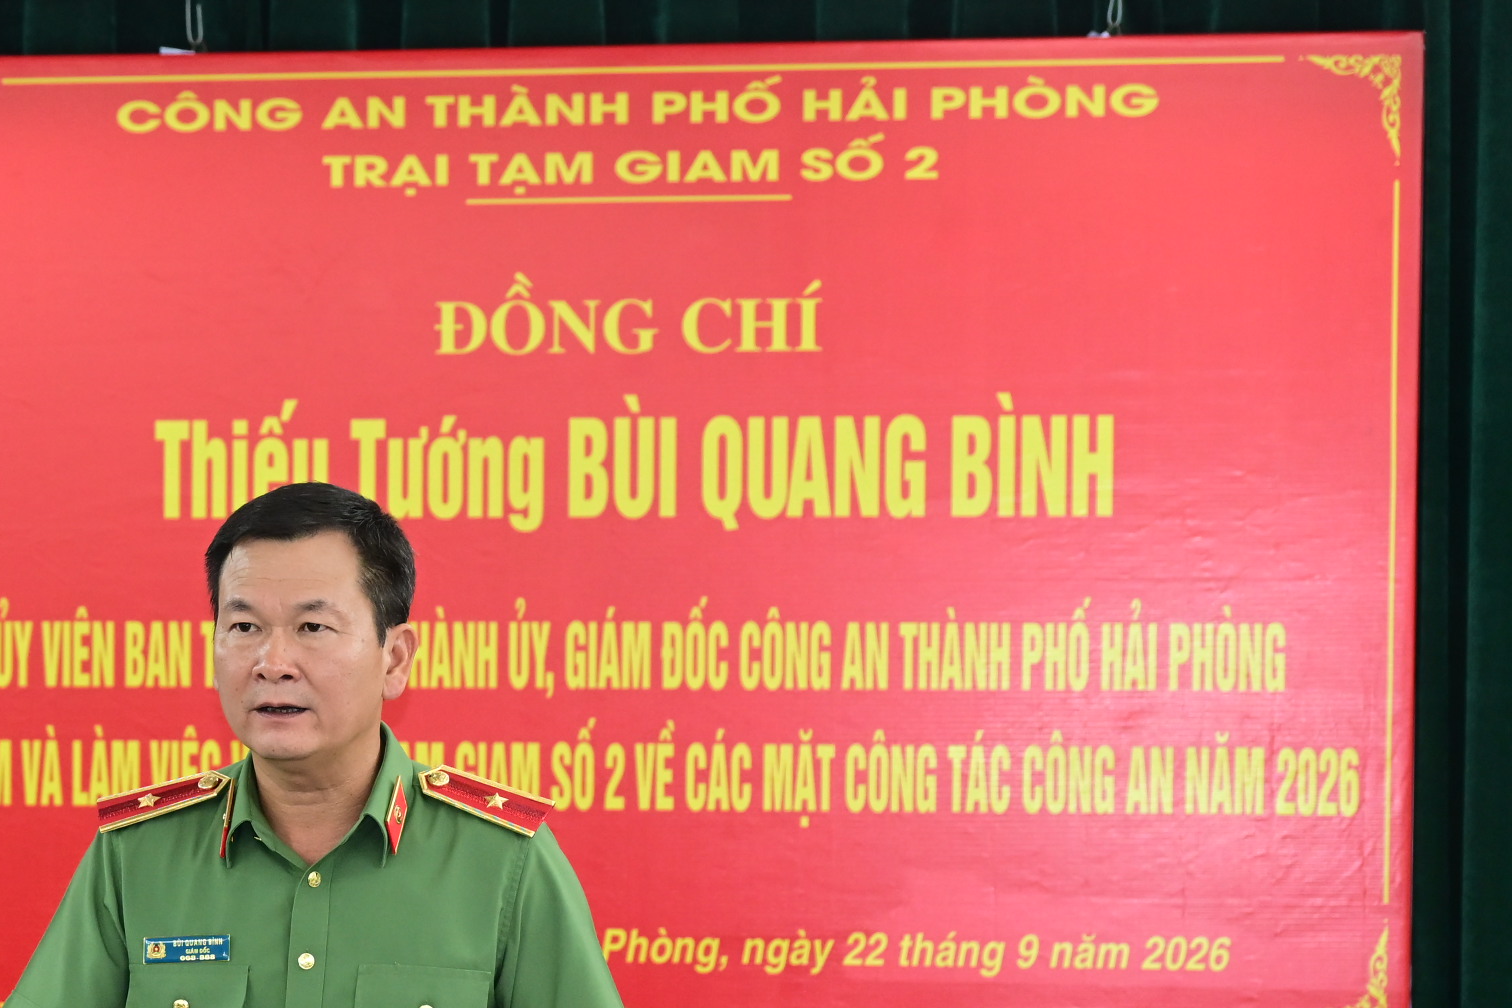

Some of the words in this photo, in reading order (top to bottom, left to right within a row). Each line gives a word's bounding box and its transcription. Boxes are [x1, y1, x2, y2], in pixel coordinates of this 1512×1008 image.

[117, 91, 303, 133] CÔNG
[323, 96, 406, 129] AN
[426, 85, 629, 128] THÀNH
[653, 75, 782, 124] PHỐ
[803, 76, 907, 121] HẢI
[931, 76, 1159, 120] PHÒNG
[323, 154, 449, 196] TRẠI
[469, 152, 594, 195] TẠM
[616, 149, 780, 184] GIAM
[801, 133, 884, 181] SỐ
[906, 146, 939, 180] 2
[436, 272, 657, 355] ĐỒNG
[682, 280, 822, 353] CHÍ
[155, 399, 329, 519] Thiếu
[350, 415, 545, 532] Tướng
[568, 394, 677, 519] BÙI
[702, 414, 927, 530] QUANG
[952, 392, 1114, 517] BÌNH
[42, 606, 116, 688] VIÊN
[125, 621, 192, 688] BAN
[408, 607, 499, 688] HÀNH
[509, 598, 555, 697] ỦY,
[566, 607, 652, 690] GIÁM
[661, 597, 729, 690] ĐỐC
[740, 607, 832, 690] CÔNG
[842, 622, 889, 690] AN
[900, 608, 1011, 690] THÀNH
[1023, 598, 1090, 690] PHỐ
[1102, 600, 1157, 690] HẢI
[1170, 607, 1285, 691] PHÒNG
[21, 725, 82, 806] VÀ
[90, 725, 140, 806] LÀM
[550, 718, 596, 811] SỐ
[605, 743, 626, 810] 2
[635, 720, 675, 811] VỀ
[686, 729, 752, 812] CÁC
[764, 730, 835, 827] MẶT
[846, 730, 937, 813] CÔNG
[949, 731, 1010, 813] TÁC
[1024, 731, 1115, 814] CÔNG
[1127, 747, 1174, 814] AN
[1186, 731, 1265, 814] NĂM
[1277, 748, 1359, 816] 2026
[603, 928, 728, 974] Phòng,
[742, 930, 834, 974] ngày
[844, 932, 888, 966] 22
[900, 932, 1005, 977] tháng
[1018, 935, 1039, 968] 9
[1051, 936, 1129, 968] năm
[1143, 937, 1230, 971] 2026
